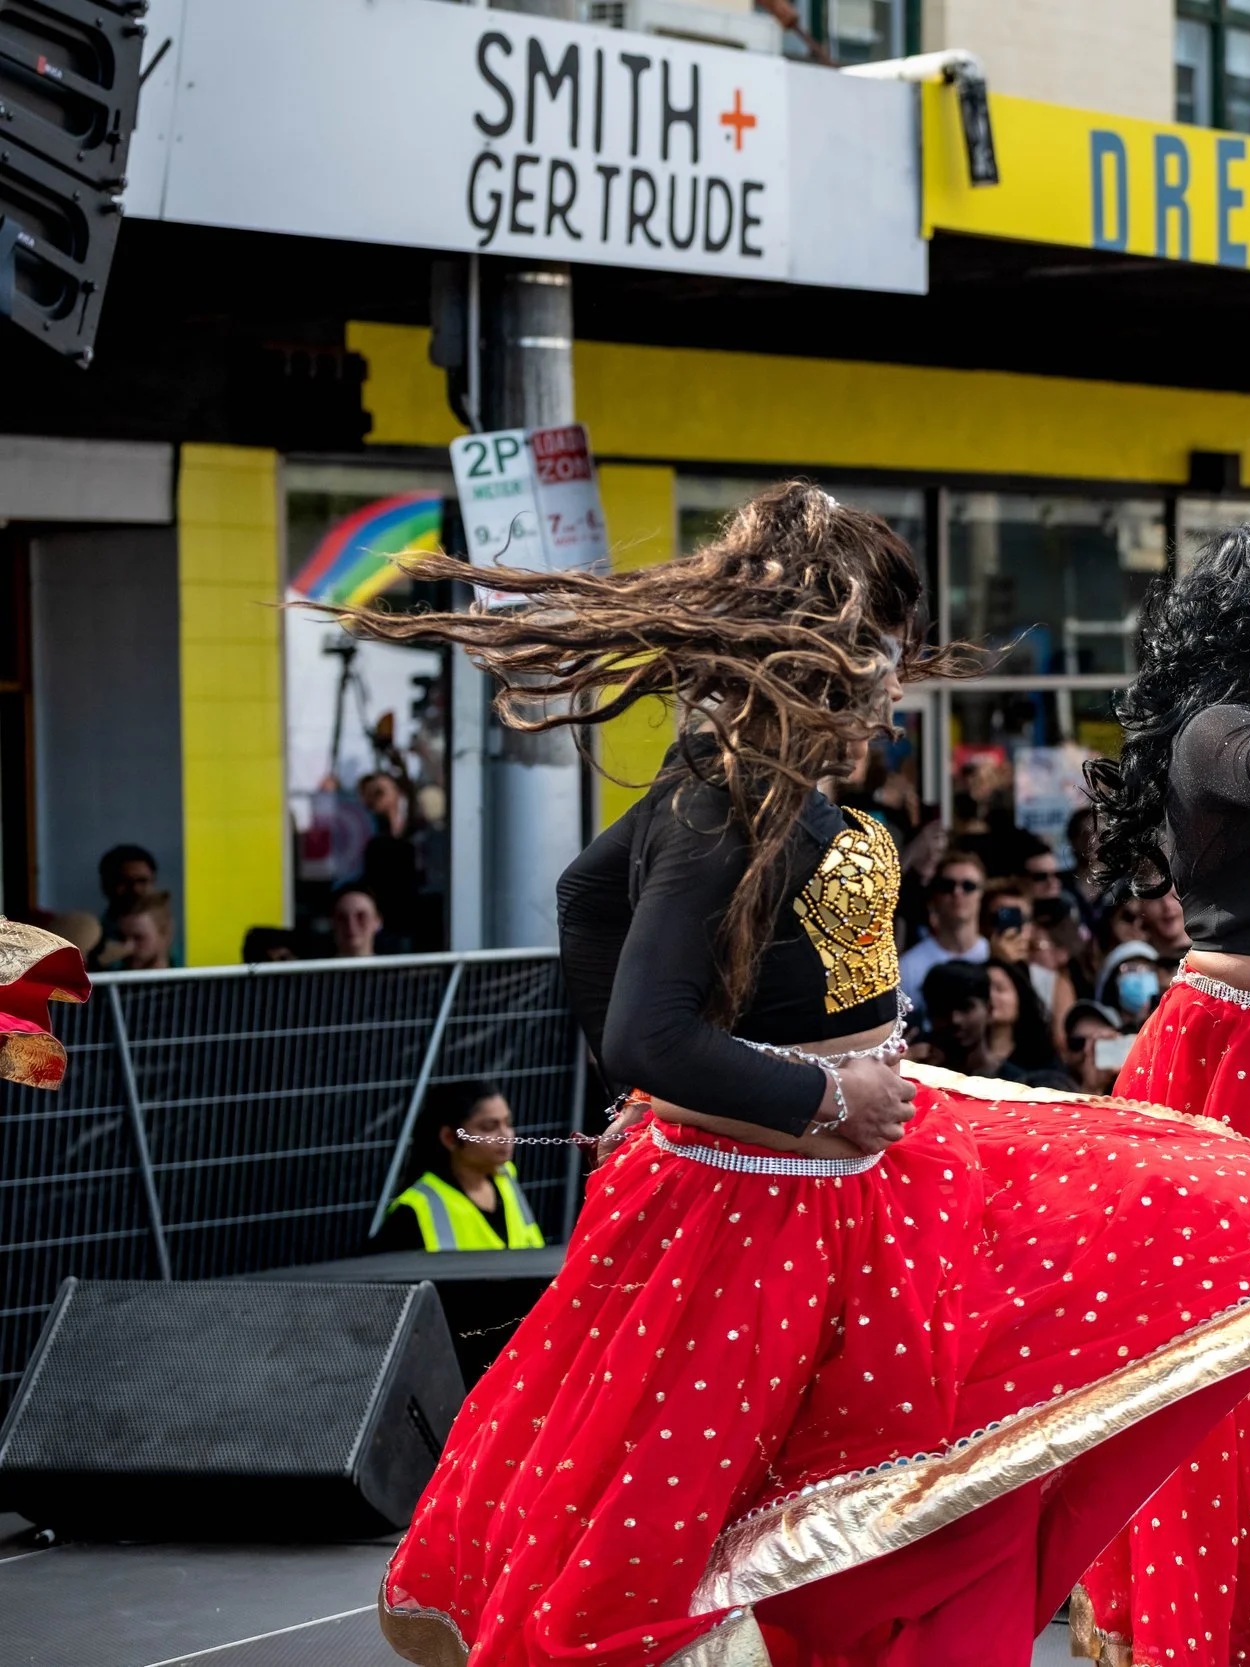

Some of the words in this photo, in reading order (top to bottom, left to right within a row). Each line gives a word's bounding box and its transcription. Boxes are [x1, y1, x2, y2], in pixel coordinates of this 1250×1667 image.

[473, 31, 700, 165] SMITH
[466, 151, 765, 258] GERTRUDE
[463, 436, 520, 478] 2P
